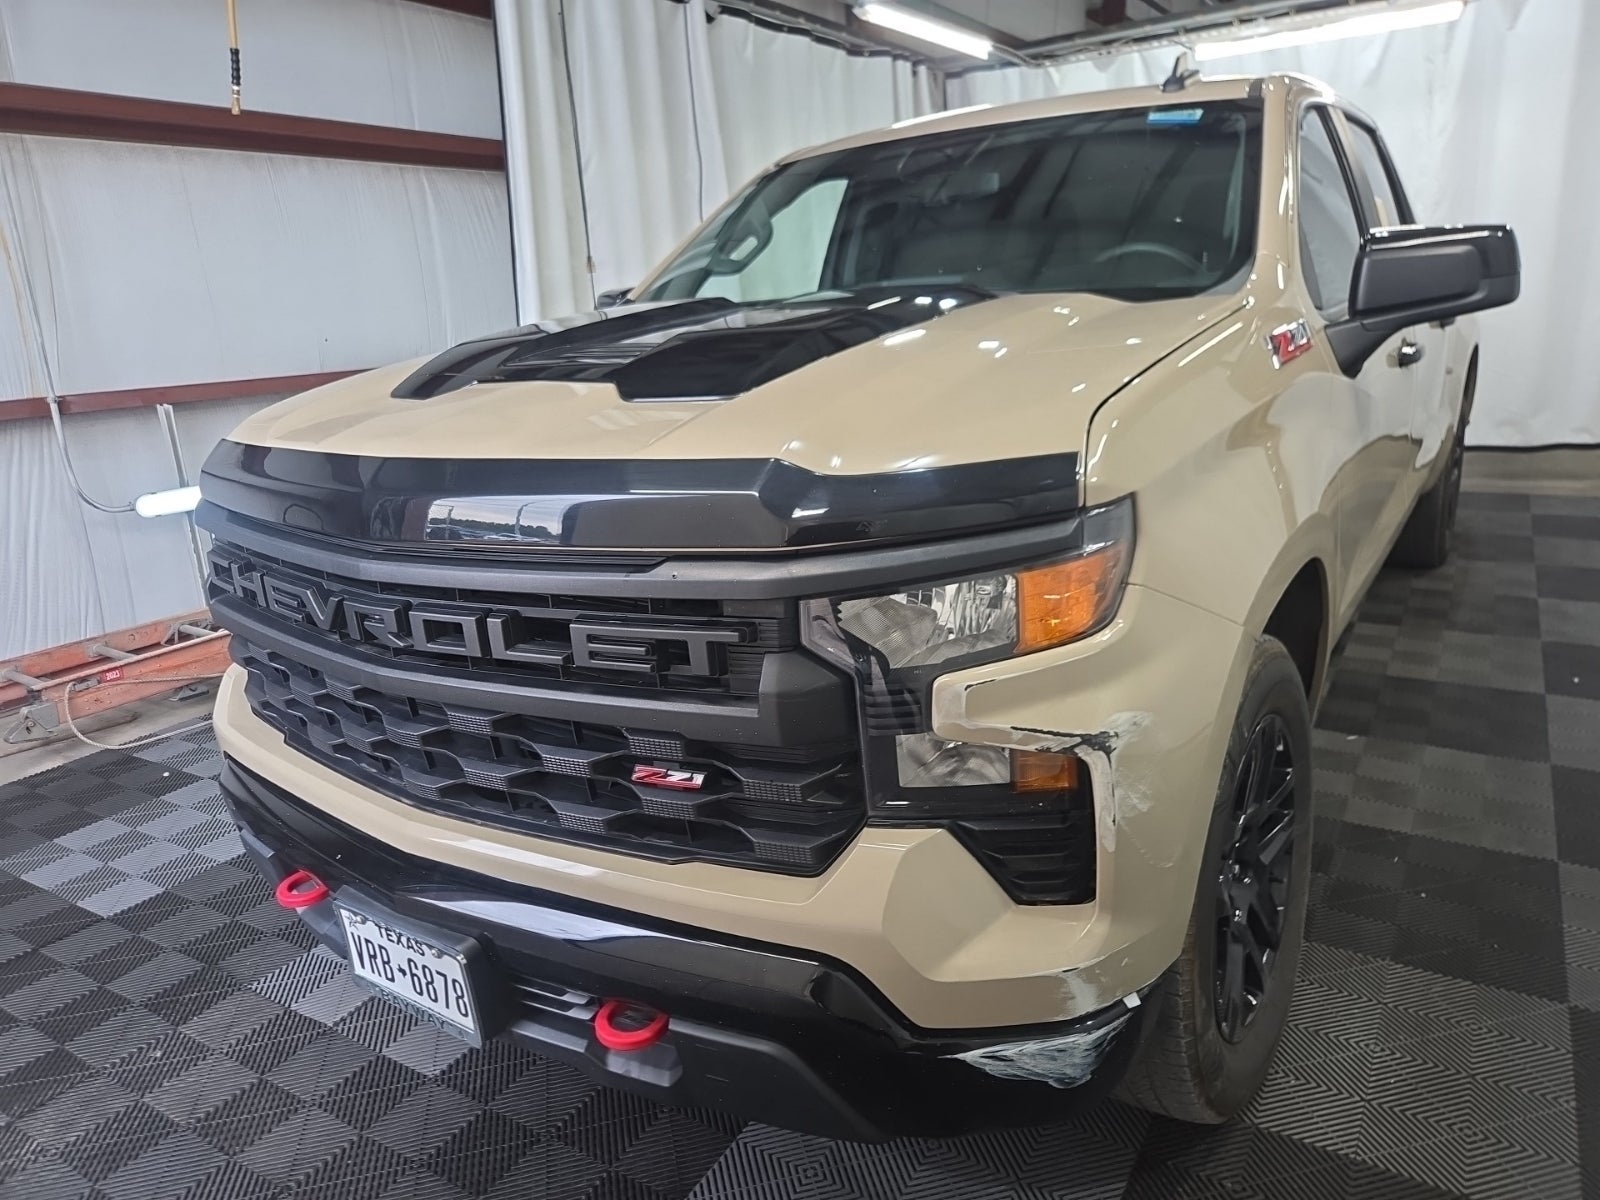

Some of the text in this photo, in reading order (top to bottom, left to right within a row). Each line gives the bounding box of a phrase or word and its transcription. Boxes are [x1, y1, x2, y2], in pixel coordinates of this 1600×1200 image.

[206, 547, 752, 678] CHEVROLET
[631, 764, 706, 789] Z71
[375, 923, 426, 957] TEXAS
